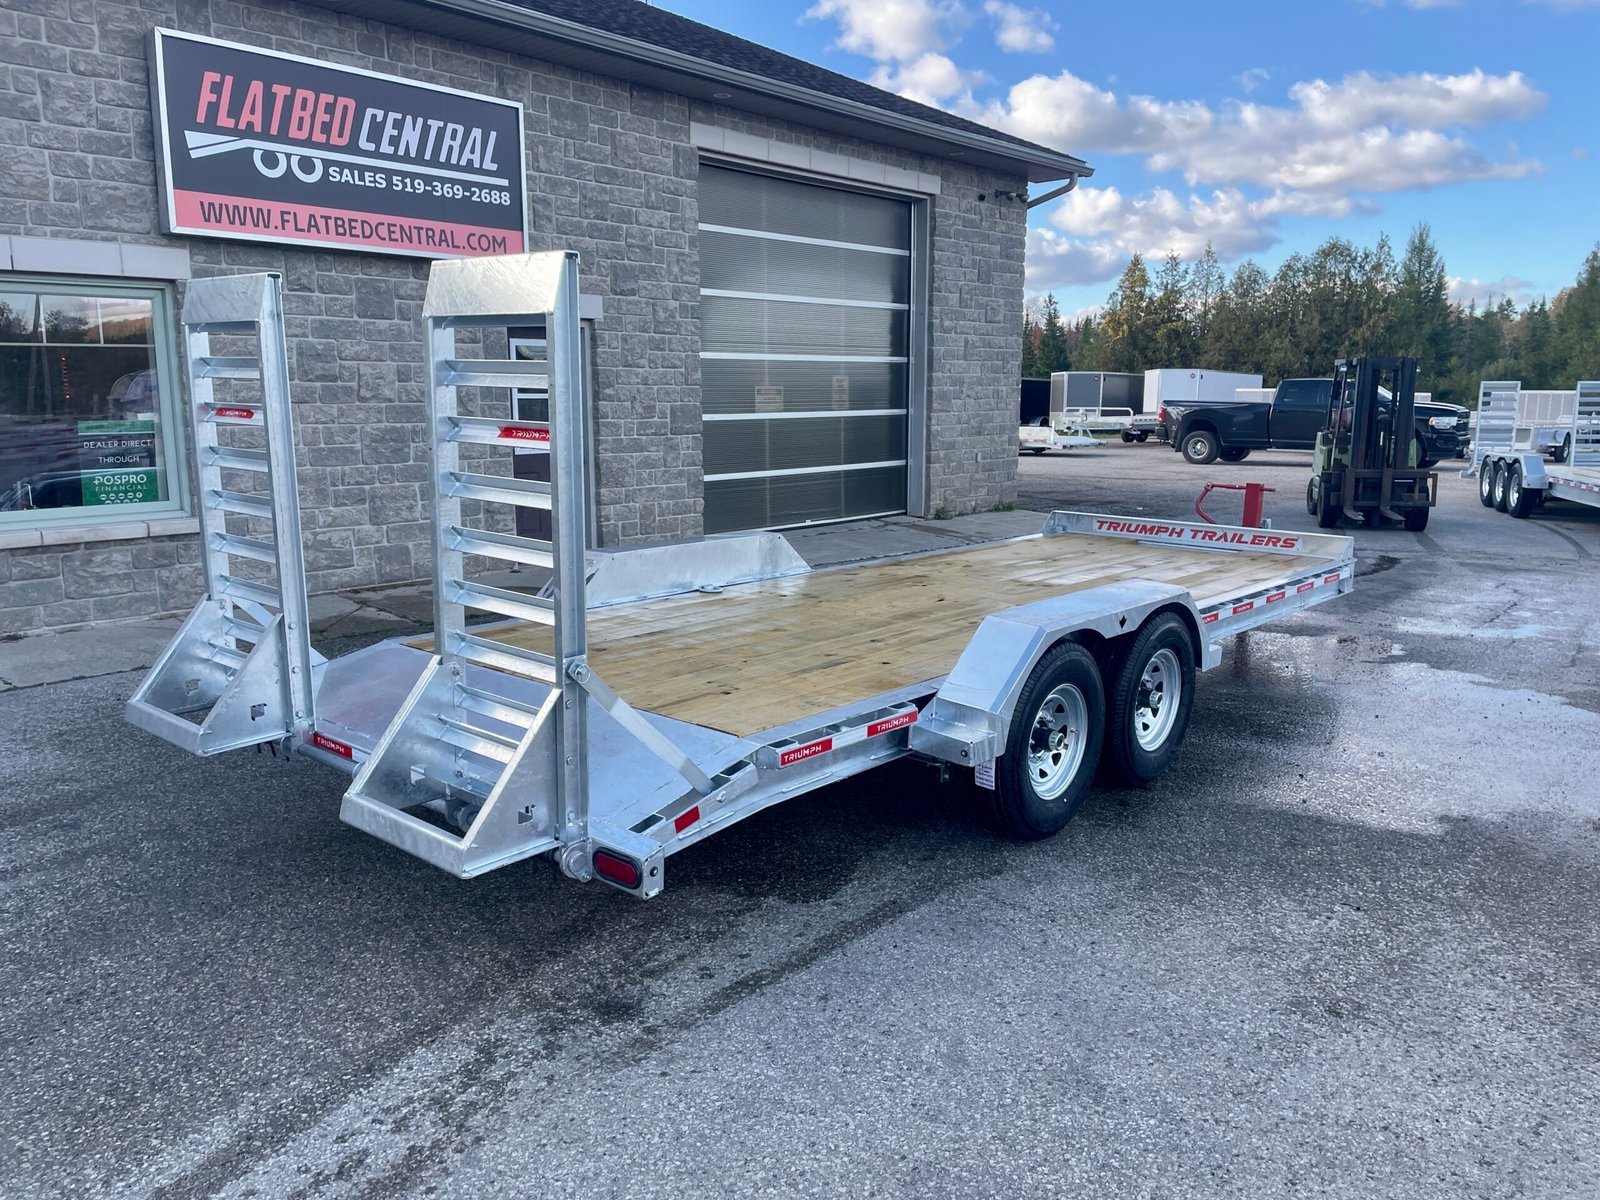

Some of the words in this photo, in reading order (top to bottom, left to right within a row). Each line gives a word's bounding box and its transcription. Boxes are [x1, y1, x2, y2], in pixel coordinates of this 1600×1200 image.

[196, 71, 356, 147] FLATBED
[358, 107, 498, 171] CENTRAL
[328, 166, 387, 188] SALES
[392, 176, 511, 206] 519-369-2688
[199, 200, 508, 255] WWW.FLATBEDCENTRAL.COM
[83, 441, 119, 449] DEALER
[121, 439, 152, 448] DIRECT
[98, 455, 140, 464] THROUGH
[93, 474, 147, 485] POSPRO
[95, 484, 148, 492] FINANCIAL
[1096, 519, 1185, 538] TRIUMPH
[1189, 528, 1299, 549] TRAILERS
[877, 716, 909, 732] TRIUMPH
[317, 737, 345, 753] TRIUMPH
[784, 744, 822, 762] TRIUMPH
